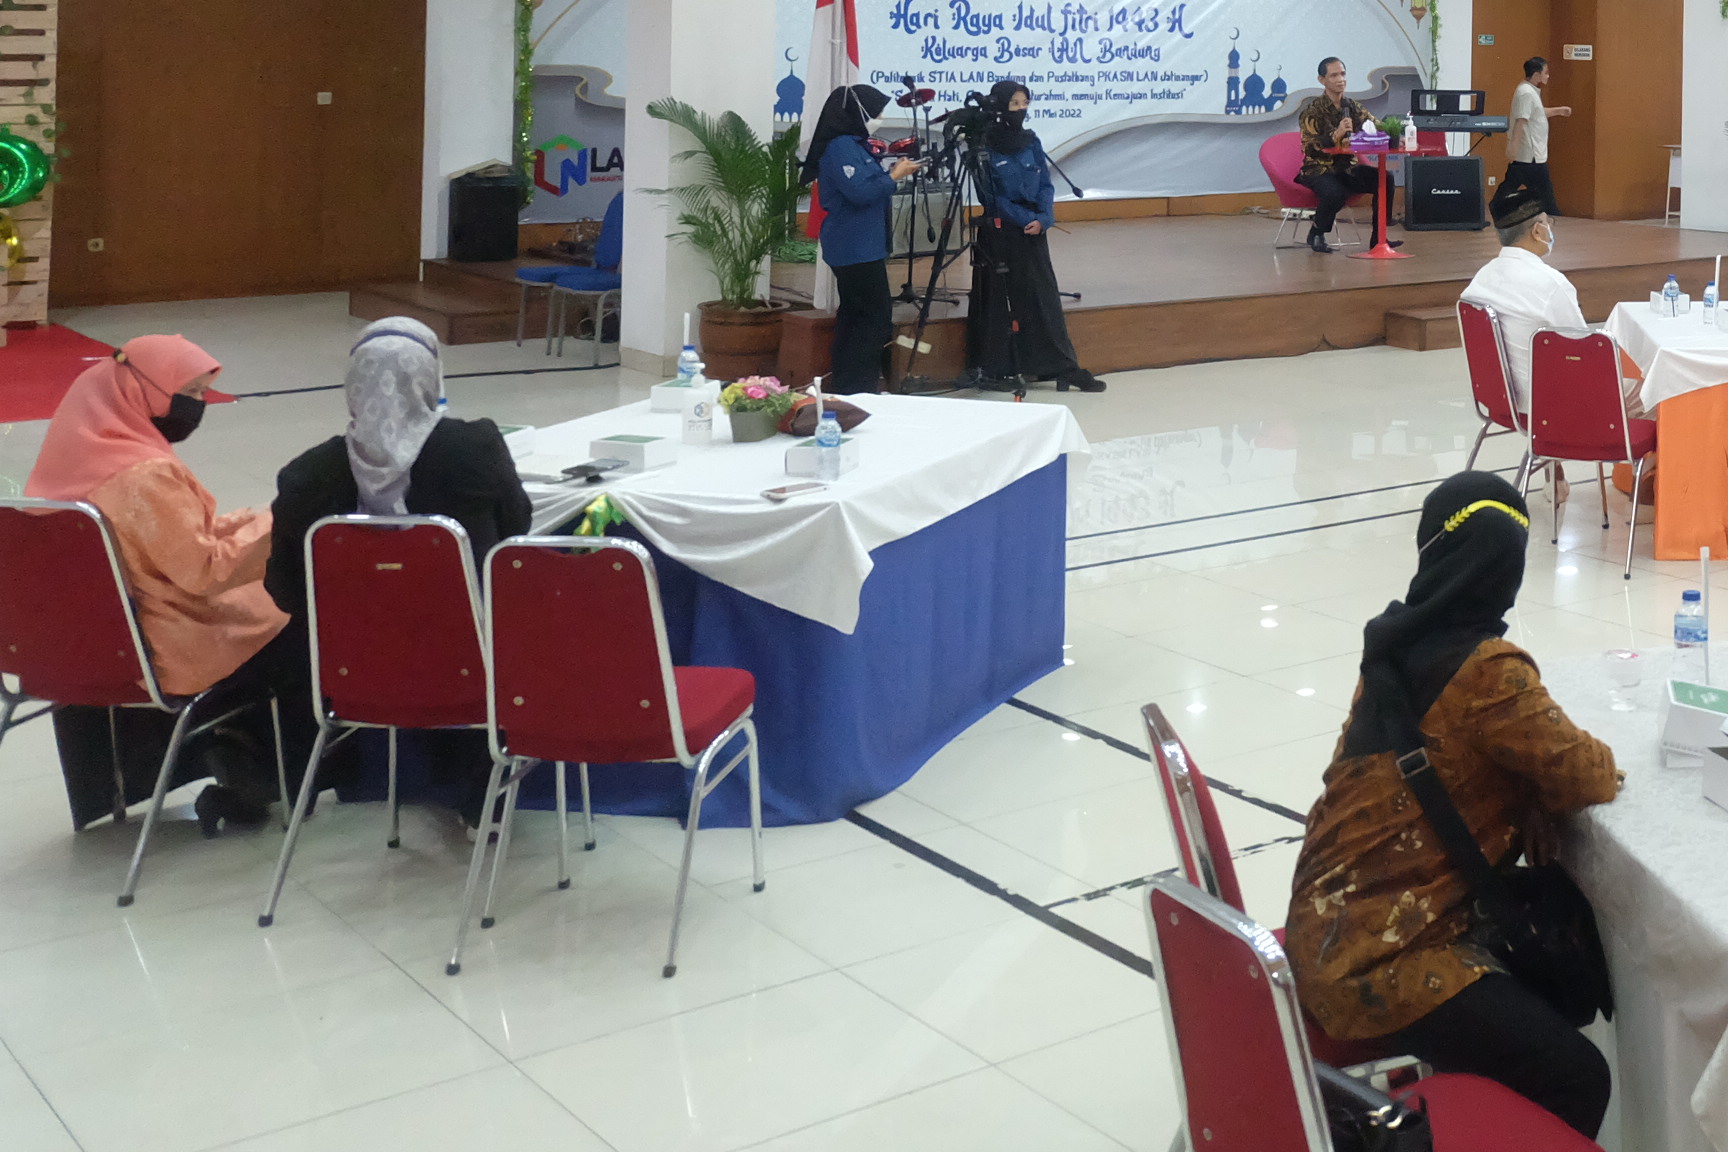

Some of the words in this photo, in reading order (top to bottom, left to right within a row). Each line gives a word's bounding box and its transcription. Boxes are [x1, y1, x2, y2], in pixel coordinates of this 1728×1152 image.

[1012, 0, 1057, 34] Idul
[1106, 6, 1160, 34] 1443
[1166, 3, 1194, 39] H
[921, 35, 989, 64] Keluarga
[993, 36, 1043, 64] Besar
[1096, 38, 1161, 65] Bandung
[928, 70, 957, 83] STIA
[960, 70, 984, 83] LAN
[1028, 71, 1044, 83] dan
[1097, 70, 1134, 83] PKASN
[1136, 70, 1158, 83] LAN
[1071, 91, 1103, 105] menuju
[1105, 89, 1148, 105] Kemajuan
[1042, 109, 1057, 119] Mei
[1059, 108, 1083, 119] 2022
